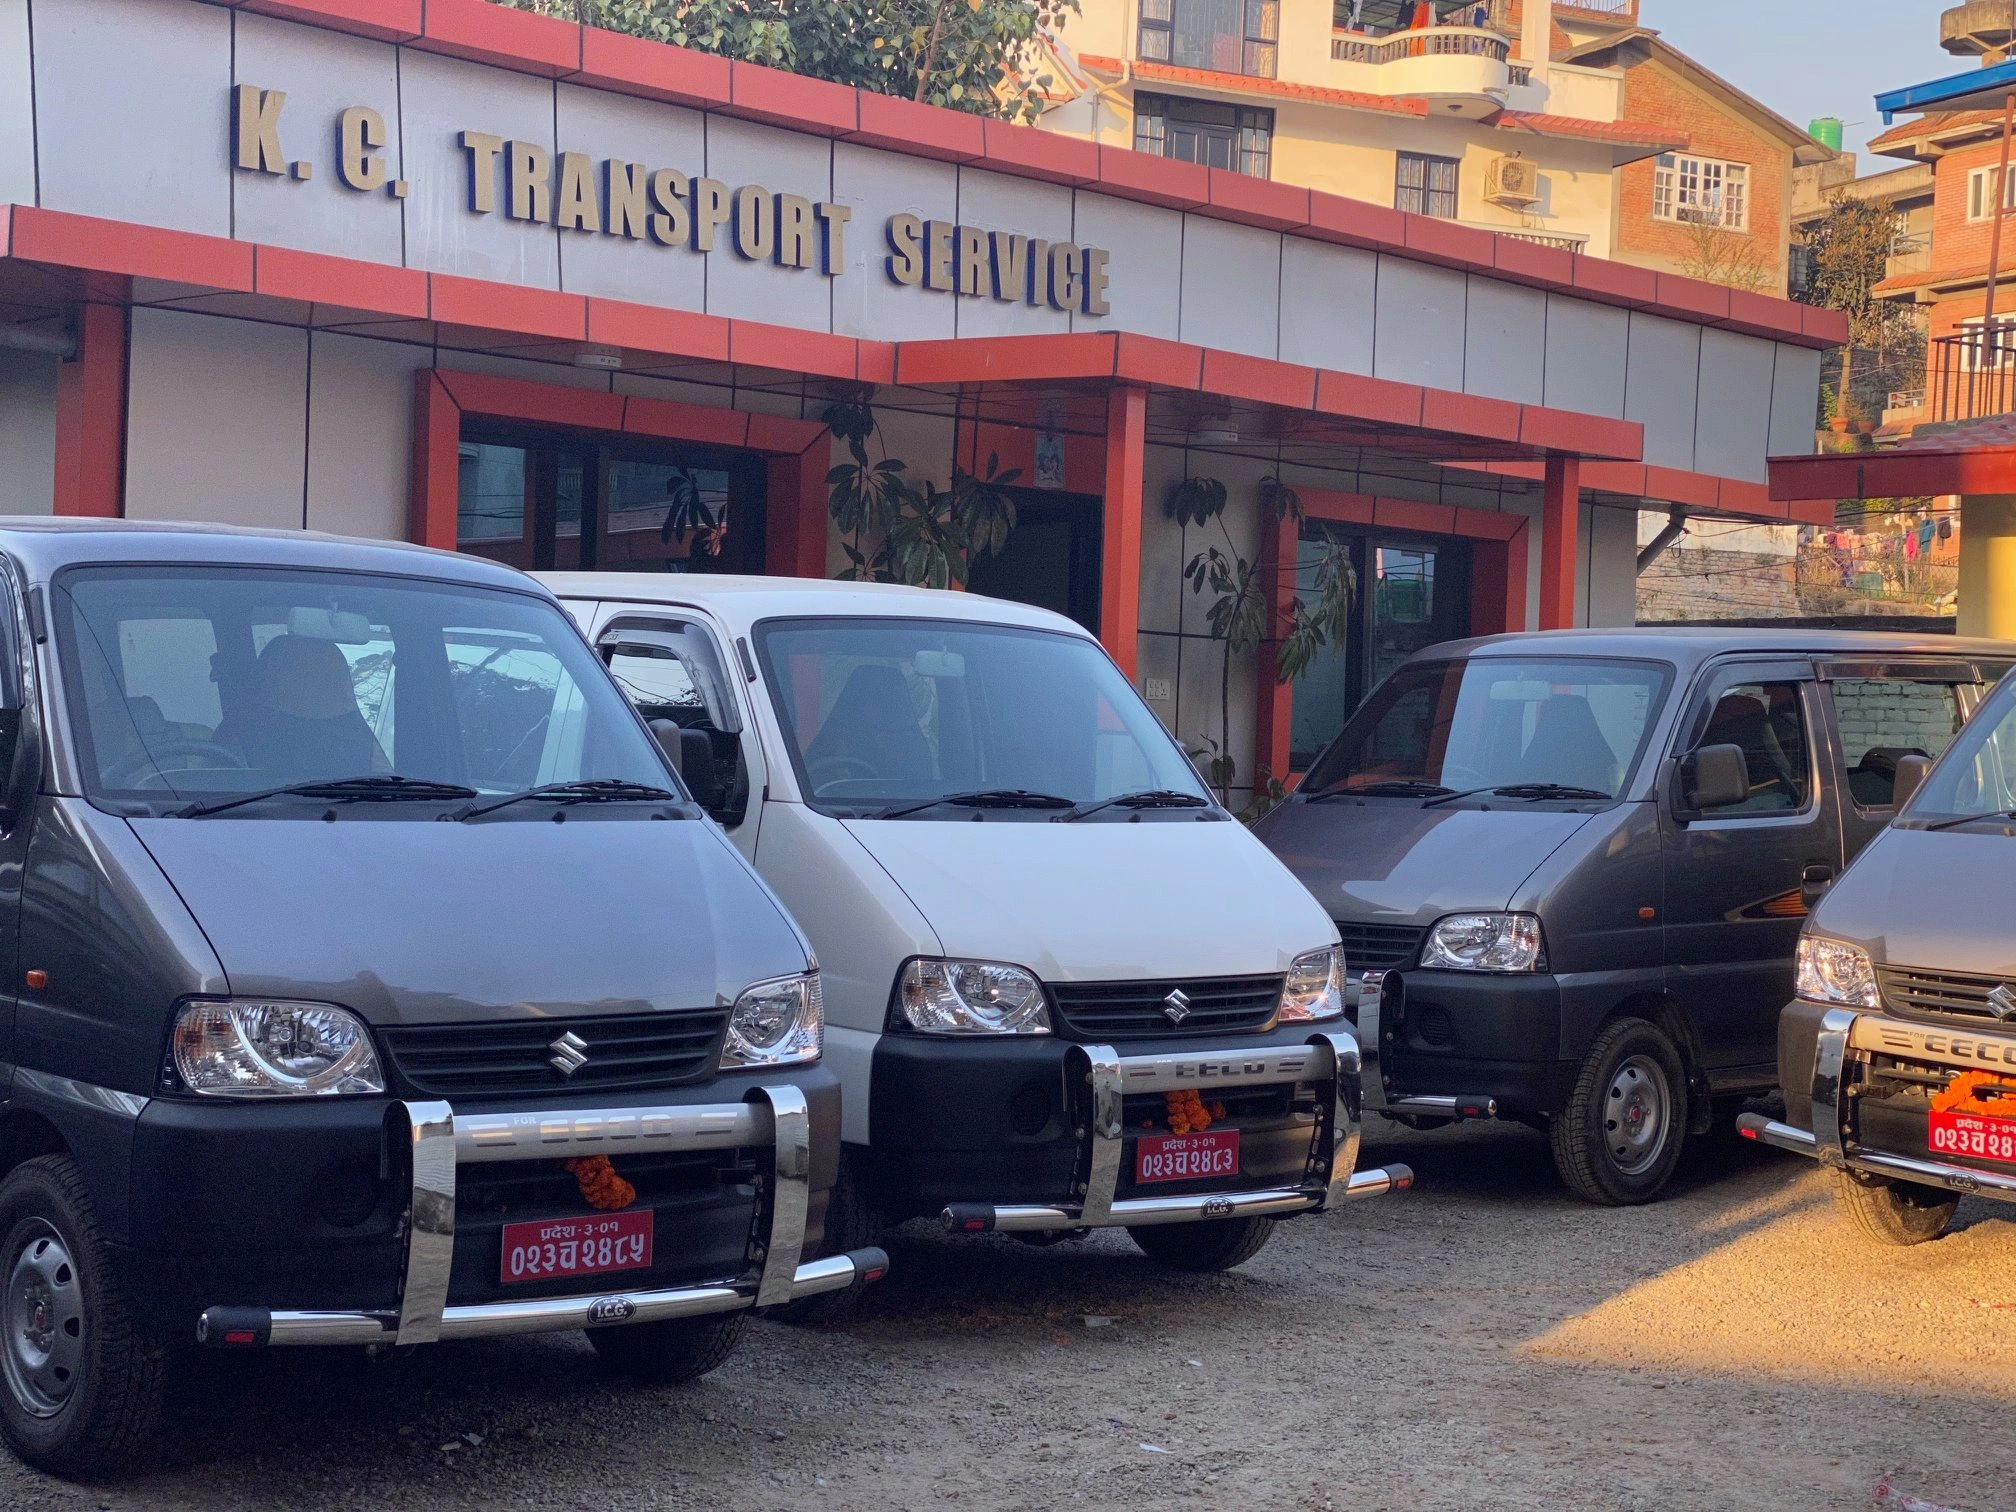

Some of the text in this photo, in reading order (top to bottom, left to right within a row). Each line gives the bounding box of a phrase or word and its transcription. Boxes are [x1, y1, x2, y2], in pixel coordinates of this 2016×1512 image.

[458, 131, 852, 276] TRANSPORT
[885, 212, 1110, 316] SERVICE
[513, 1116, 536, 1125] FOR
[1935, 1127, 2016, 1157] ०२३च२४
